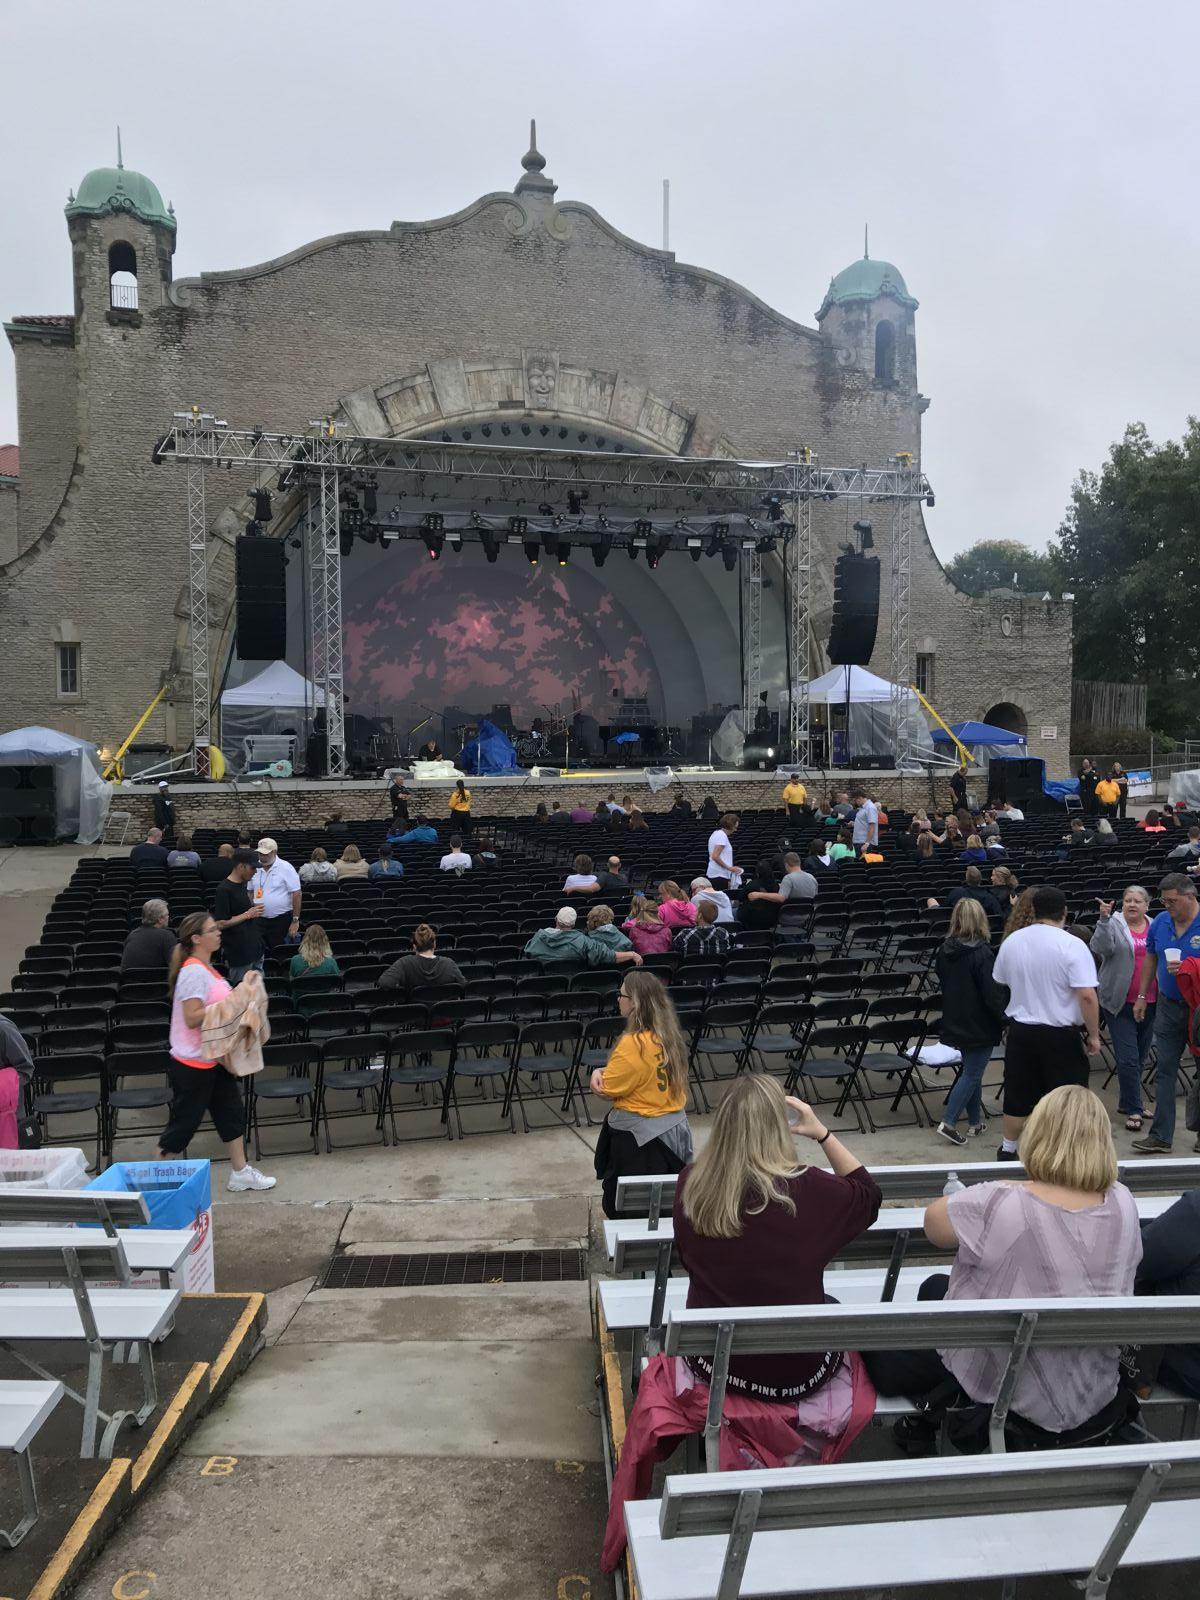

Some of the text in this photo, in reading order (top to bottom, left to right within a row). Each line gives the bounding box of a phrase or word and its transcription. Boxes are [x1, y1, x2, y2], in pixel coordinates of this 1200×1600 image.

[153, 1167, 175, 1177] Trash
[751, 1382, 777, 1397] PINK
[781, 1383, 806, 1398] PINK
[809, 1365, 827, 1388] PINK
[200, 1455, 238, 1477] B
[111, 1570, 157, 1600] C
